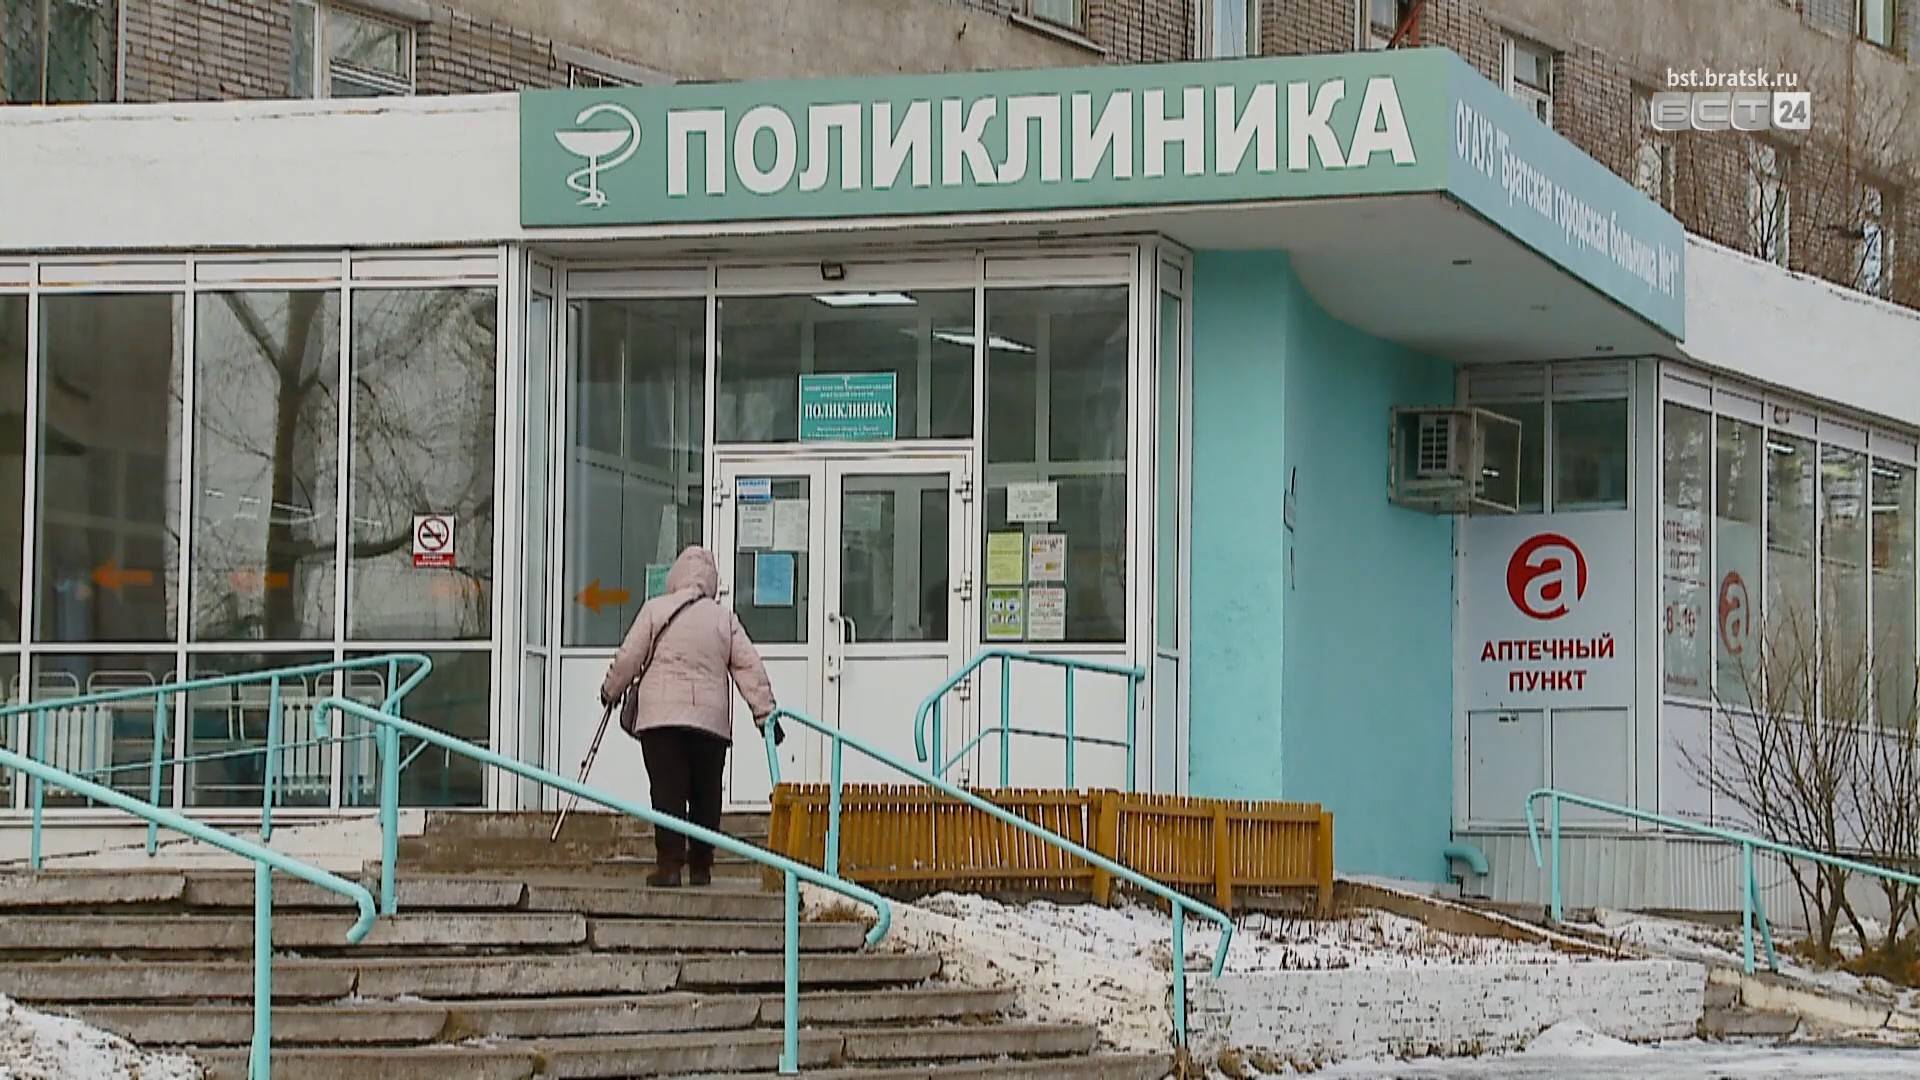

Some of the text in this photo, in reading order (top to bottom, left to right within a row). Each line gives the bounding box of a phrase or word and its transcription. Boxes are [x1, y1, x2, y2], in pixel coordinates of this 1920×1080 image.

[666, 75, 1417, 197] ПОЛИКЛИНИКА
[1456, 99, 1495, 179] ОГАУЗ
[1555, 185, 1608, 257] городская
[1609, 210, 1657, 293] больница
[804, 401, 893, 419] ПОЛИКЛИНИКА
[1481, 632, 1615, 662] АПТЕЧНЫЙ
[1508, 670, 1587, 692] ПУНКТ
